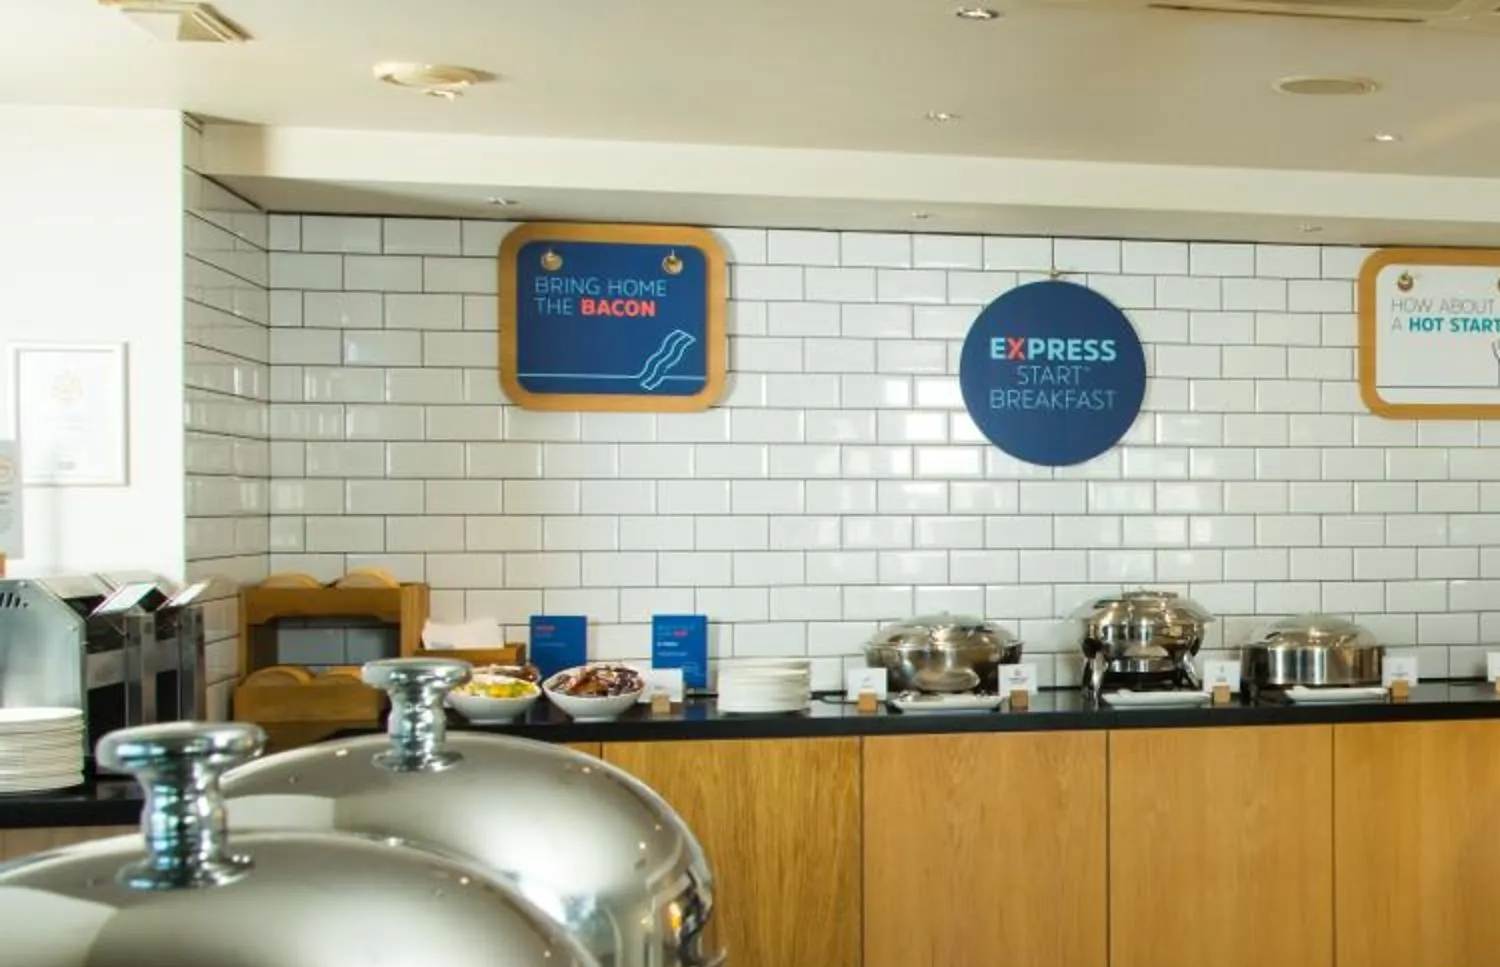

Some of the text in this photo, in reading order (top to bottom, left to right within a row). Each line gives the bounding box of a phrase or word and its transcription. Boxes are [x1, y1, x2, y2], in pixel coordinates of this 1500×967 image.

[534, 276, 667, 297] BRING HOME
[534, 296, 656, 317] THE BACON
[1391, 298, 1495, 315] HOW ABOUT
[1391, 317, 1402, 332] A
[1408, 317, 1444, 332] HOT
[990, 337, 1117, 361] EXPRESS
[990, 388, 1117, 410] BREAKFAST
